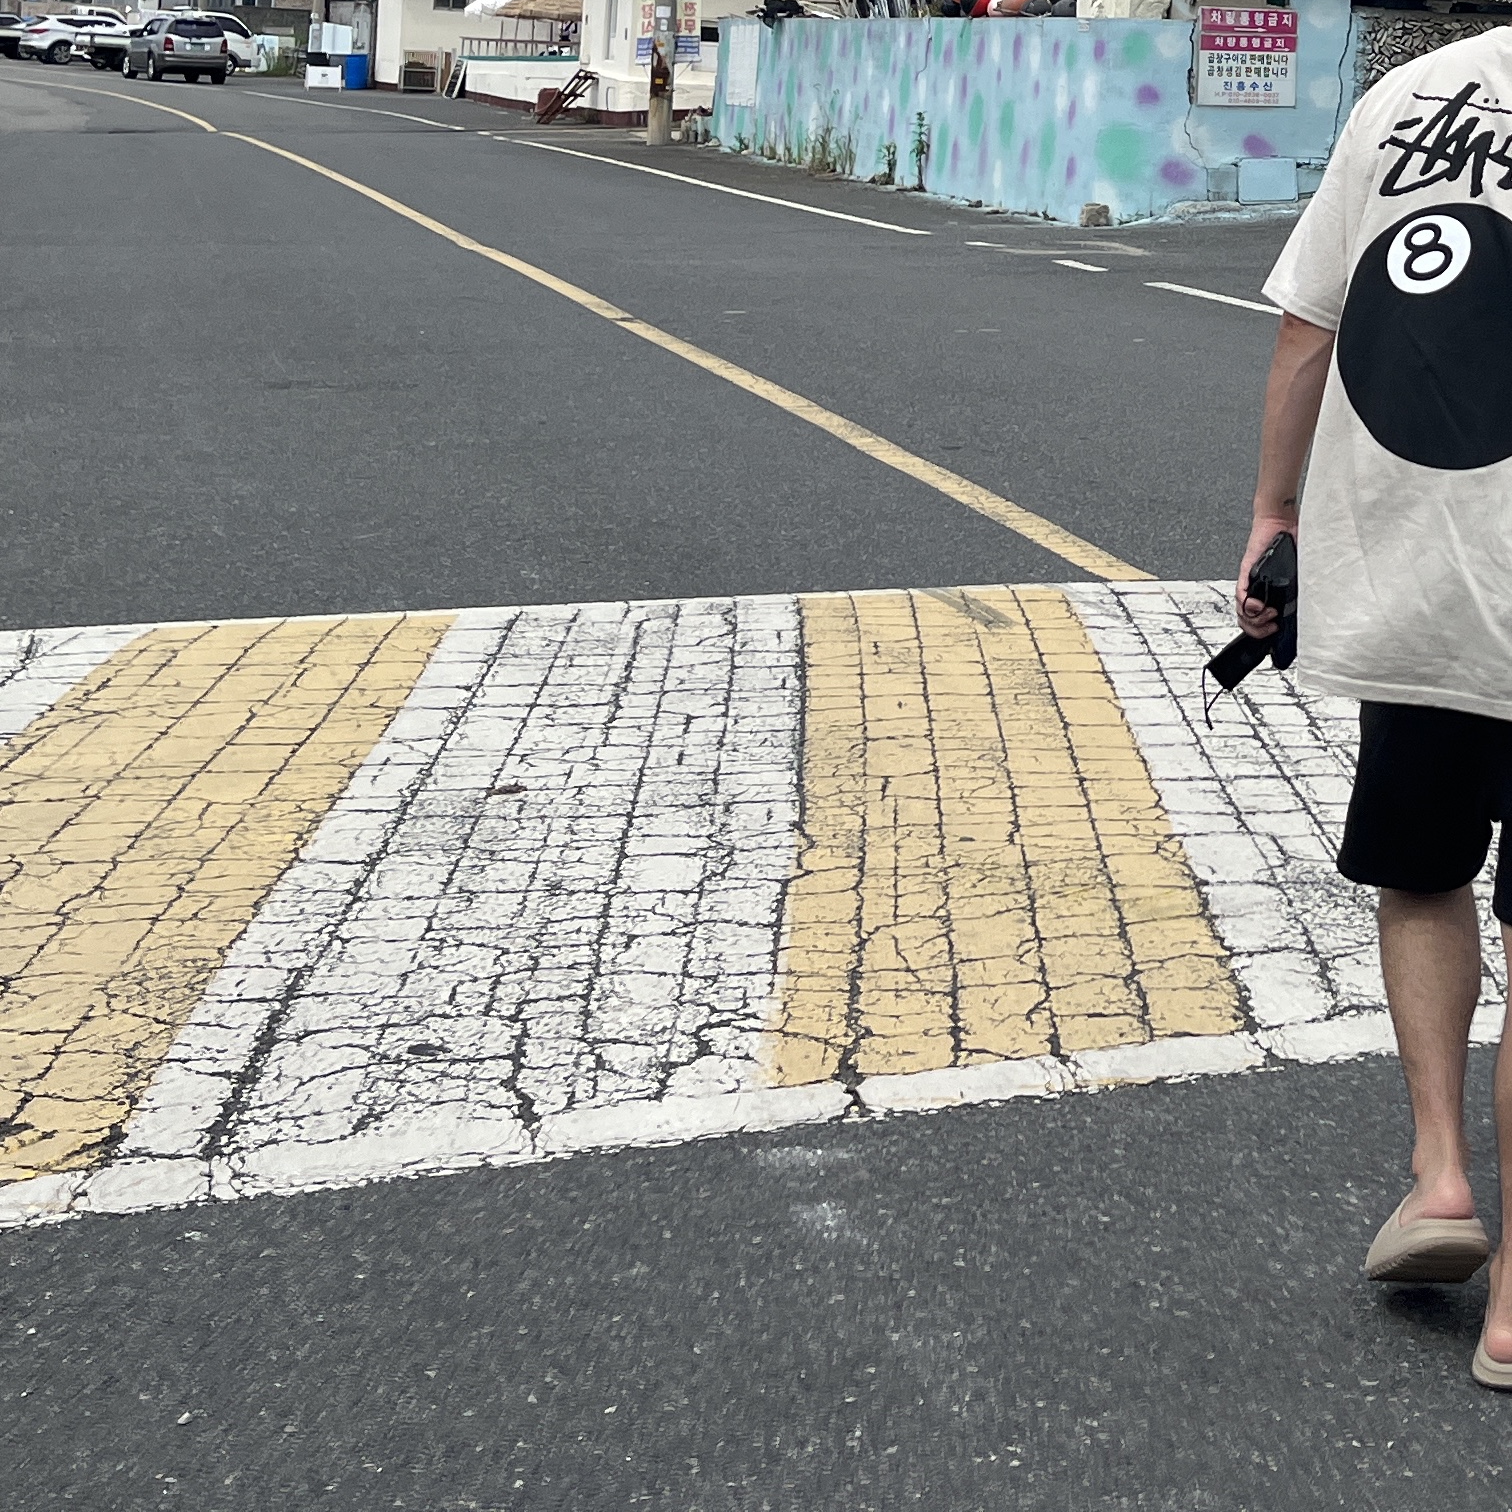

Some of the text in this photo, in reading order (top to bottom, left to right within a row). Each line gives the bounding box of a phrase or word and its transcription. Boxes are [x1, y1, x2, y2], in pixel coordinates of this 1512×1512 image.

[1210, 10, 1293, 27] 차량통행금지
[1214, 36, 1285, 48] 차량통행금지
[1207, 53, 1289, 65] 곱창구이김 판매합니다
[1207, 65, 1288, 78] 곱창생김 판매합니다
[1404, 222, 1453, 281] 8
